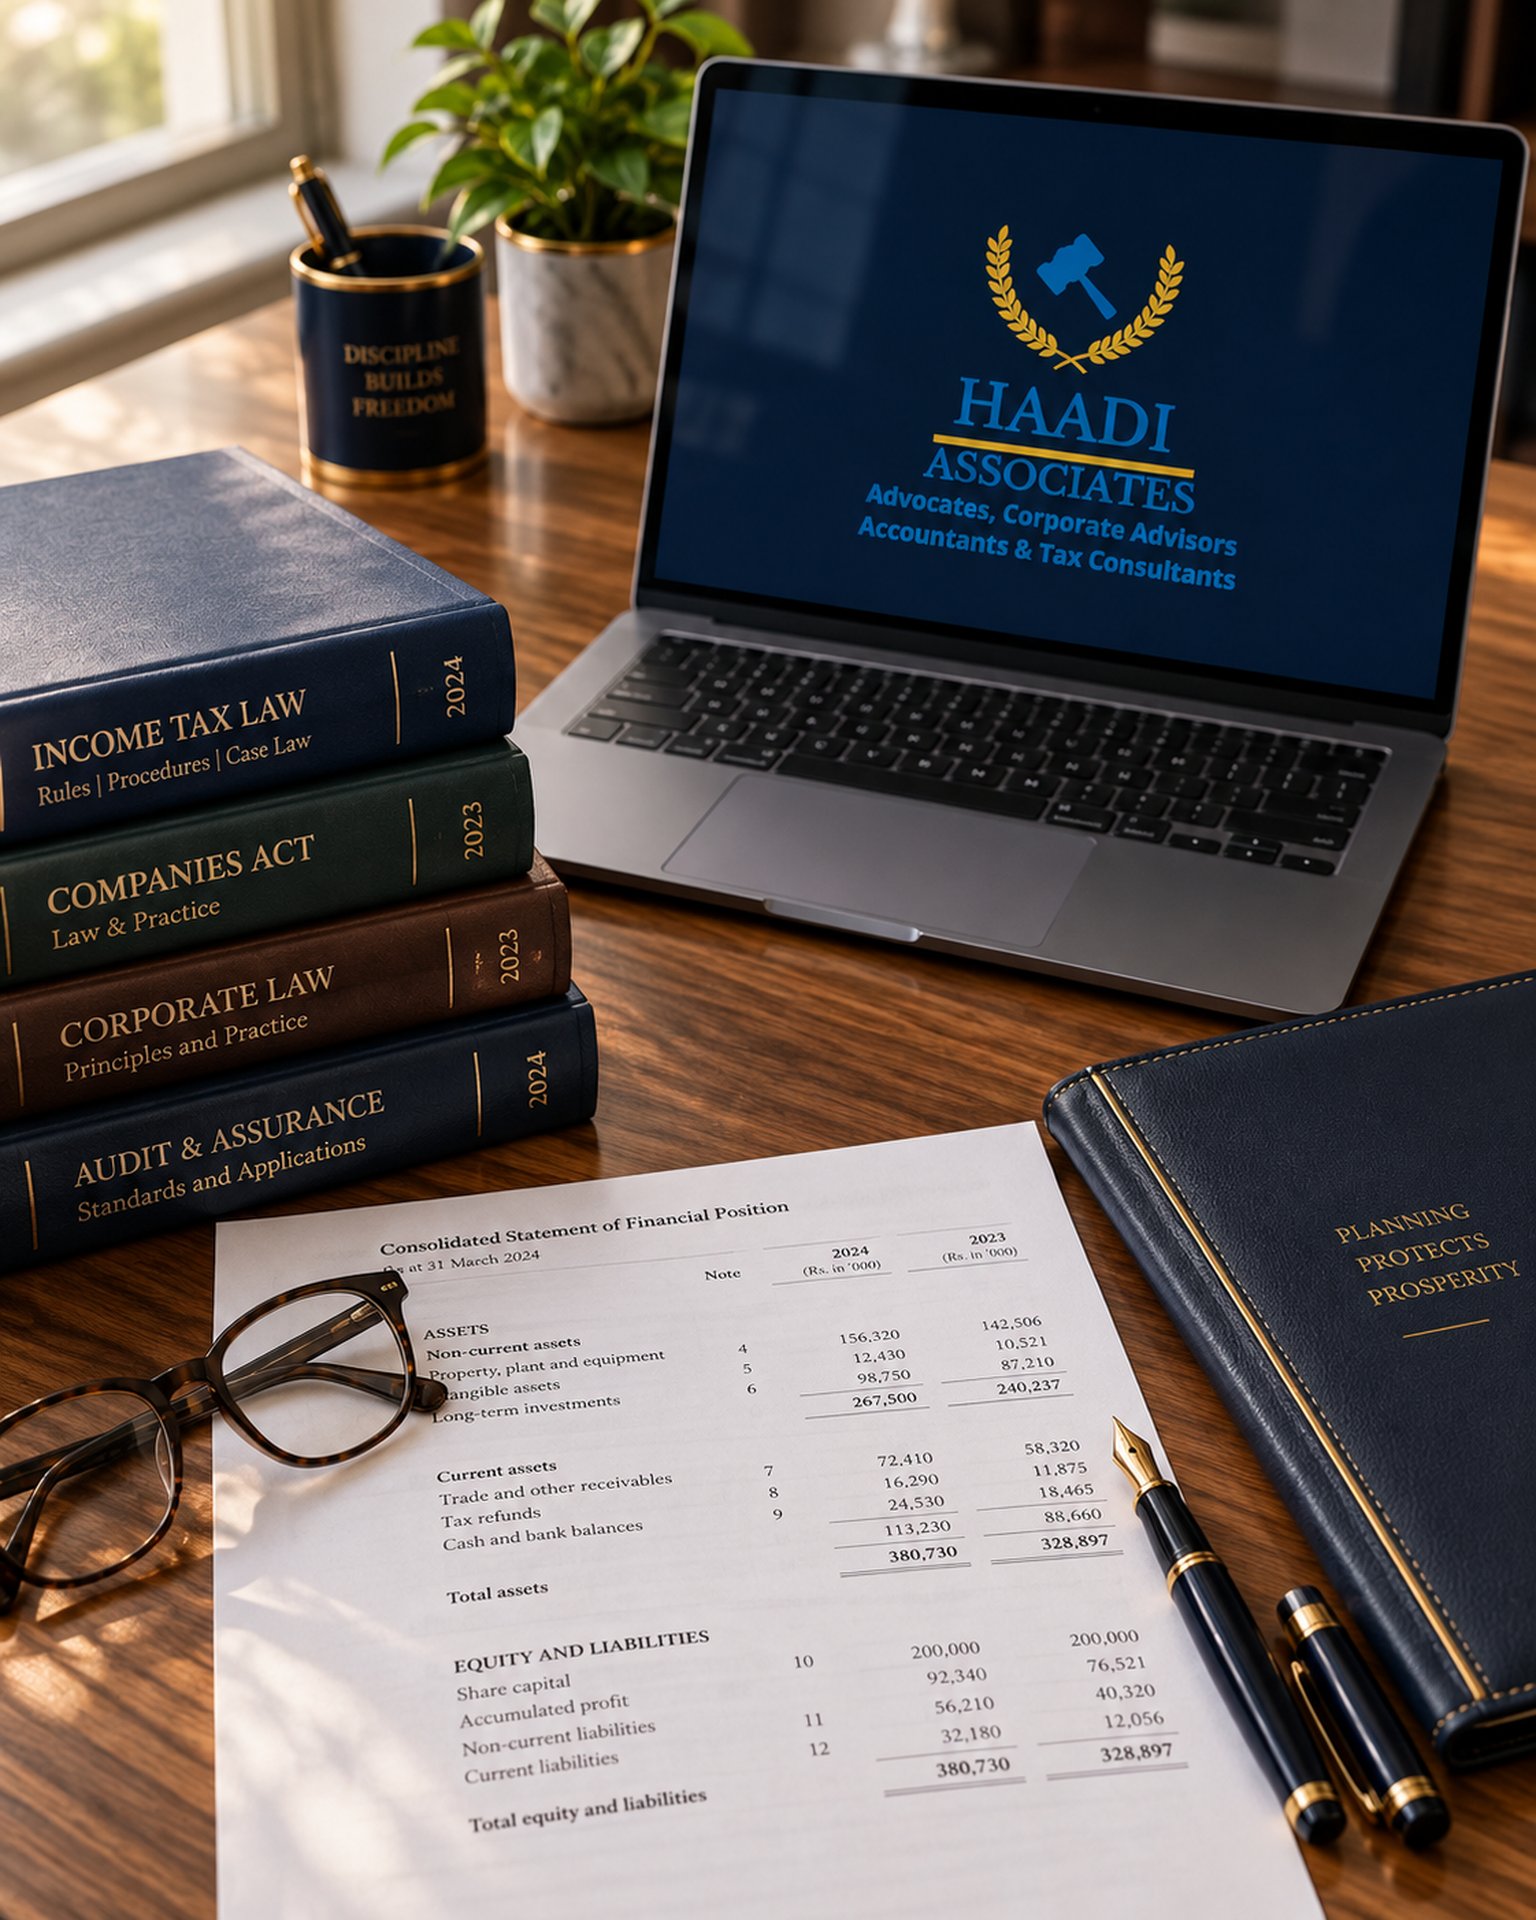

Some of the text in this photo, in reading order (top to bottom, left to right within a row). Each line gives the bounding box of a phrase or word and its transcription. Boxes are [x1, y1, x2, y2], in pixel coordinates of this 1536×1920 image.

[343, 335, 459, 366] DISCIPLINE
[364, 366, 444, 392] BUILDS
[352, 389, 456, 418] FREEDOM
[953, 376, 1176, 454] HAADI
[922, 446, 1196, 514] ASSOCIATES
[865, 483, 1238, 557] Advocates, Corporate Advisors
[857, 515, 1236, 591] Accountants & Tax Consultants
[443, 655, 467, 719] 2024
[31, 688, 307, 772] INCOME TAX LAW
[37, 780, 92, 807] Rules
[107, 757, 211, 792] Procedures
[225, 744, 269, 765] Case
[273, 734, 312, 756] Law
[461, 801, 485, 861] 2023
[47, 833, 315, 915] COMPANIES ACT
[51, 900, 221, 950] Law & Practice
[498, 928, 520, 985] 2023
[60, 964, 335, 1048] CORPORATE LAW
[64, 1014, 308, 1083] Principles and Practice
[526, 1050, 549, 1109] 2024
[74, 1089, 385, 1188] AUDIT & ASSURANCE
[78, 1137, 367, 1222] Standards and Applications
[379, 1201, 790, 1256] Consolidated Statement of Financial Position
[1334, 1203, 1470, 1245] PLANNING
[968, 1231, 1007, 1246] 2023
[408, 1263, 423, 1273] at
[427, 1259, 444, 1272] 31
[450, 1253, 499, 1269] March
[503, 1249, 540, 1264] 2024
[831, 1245, 870, 1260] 2024
[941, 1251, 968, 1264] (Rs.
[969, 1251, 983, 1260] in
[1355, 1232, 1490, 1274] PROTECTS
[704, 1269, 742, 1281] Note
[802, 1265, 830, 1278] (Rs.
[831, 1263, 846, 1274] in
[1367, 1259, 1521, 1307] PROSPERITY
[423, 1323, 490, 1341] ASSETS
[982, 1315, 1043, 1333] 142,506
[839, 1329, 901, 1346] 156,320
[995, 1335, 1048, 1352] 10,521
[426, 1338, 582, 1362] Non-current assets
[737, 1343, 748, 1354] 4
[852, 1348, 906, 1365] 12,430
[428, 1351, 666, 1382] Property, plant and equipment
[742, 1363, 753, 1375] 5
[1000, 1356, 1055, 1373] 87,210
[513, 1381, 561, 1394] assets
[856, 1368, 912, 1386] 98,750
[996, 1378, 1061, 1397] 240,237
[746, 1383, 757, 1395] 6
[431, 1396, 621, 1424] Long-term investments
[851, 1391, 918, 1410] 267,500
[1024, 1439, 1081, 1457] 58,320
[763, 1464, 774, 1477] 7
[876, 1451, 934, 1469] 72,410
[1033, 1461, 1088, 1478] 11,875
[436, 1461, 558, 1484] Current assets
[884, 1473, 940, 1490] 16,290
[438, 1472, 673, 1506] Trade and other receivables
[768, 1486, 779, 1499] 8
[1039, 1482, 1095, 1500] 18,465
[887, 1494, 945, 1513] 24,530
[440, 1506, 542, 1529] Tax refunds
[772, 1508, 783, 1521] 9
[1043, 1507, 1102, 1525] 88,660
[442, 1521, 644, 1552] Cash and bank balances
[884, 1519, 952, 1539] 113,230
[1040, 1533, 1109, 1552] 328,897
[888, 1545, 958, 1565] 380,730
[445, 1583, 549, 1605] Total assets
[1069, 1629, 1140, 1649] 200,000
[453, 1629, 710, 1674] EQUITY AND LIABILITIES
[910, 1640, 981, 1660] 200,000
[794, 1654, 815, 1669] 10
[1086, 1655, 1146, 1674] 76,521
[456, 1673, 571, 1702] Share capital
[926, 1667, 988, 1687] 92,340
[1095, 1683, 1156, 1702] 40,320
[459, 1693, 630, 1729] Accumulated profit
[934, 1695, 995, 1716] 56,210
[804, 1712, 824, 1728] 11
[1104, 1710, 1165, 1730] 12,056
[462, 1720, 657, 1758] Non-current liabilities
[940, 1724, 1002, 1745] 32,180
[809, 1741, 831, 1757] 12
[1100, 1742, 1173, 1764] 328,897
[464, 1752, 620, 1785] Current liabilities
[935, 1756, 1011, 1779] 380,730
[467, 1789, 708, 1834] Total equity and liabilities
